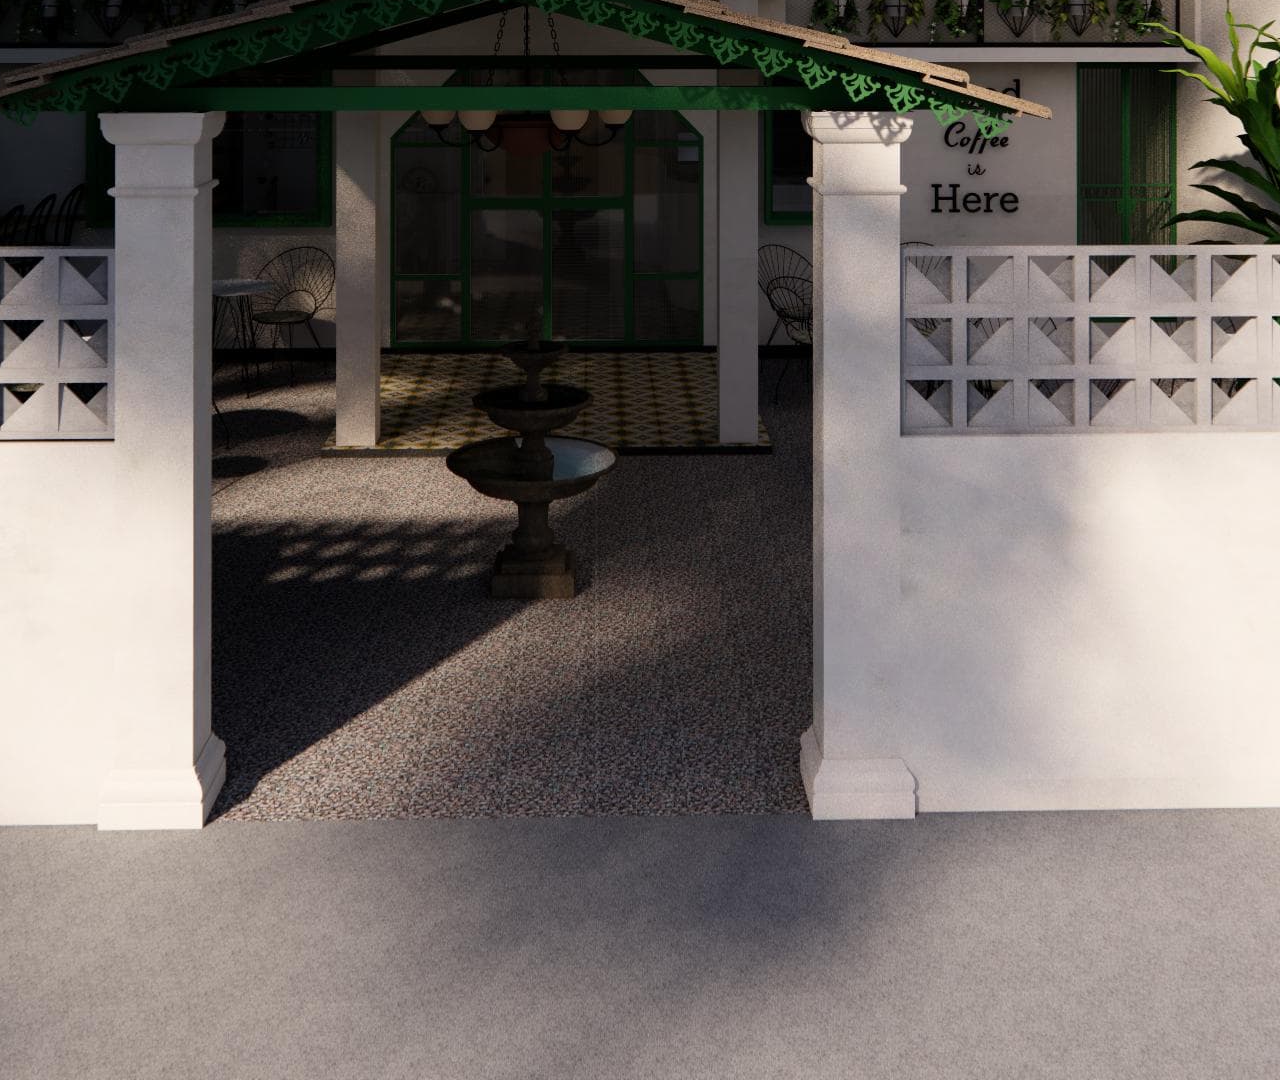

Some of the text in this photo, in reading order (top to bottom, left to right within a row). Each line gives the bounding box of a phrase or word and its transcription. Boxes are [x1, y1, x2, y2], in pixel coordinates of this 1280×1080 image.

[944, 121, 1009, 154] Coffee
[967, 162, 986, 176] is
[931, 184, 1019, 213] Here
